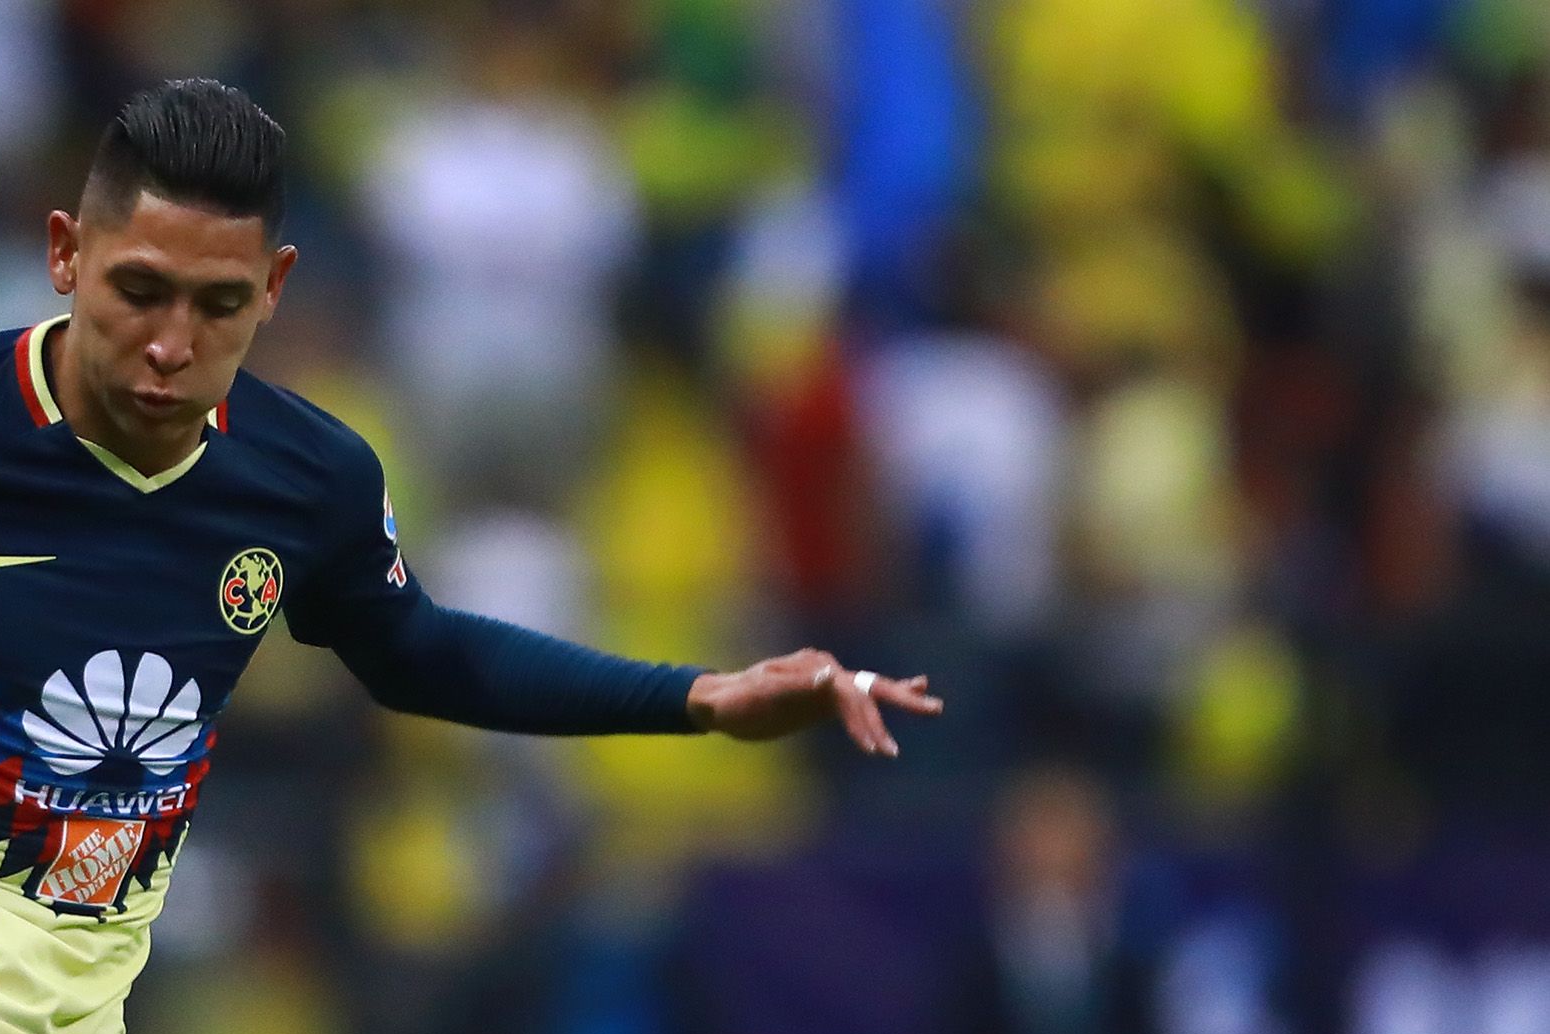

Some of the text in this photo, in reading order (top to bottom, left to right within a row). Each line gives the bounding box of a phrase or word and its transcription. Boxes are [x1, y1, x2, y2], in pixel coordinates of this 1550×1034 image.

[15, 779, 192, 814] HUAWEI
[46, 823, 140, 898] HOME
[68, 828, 105, 861] THE
